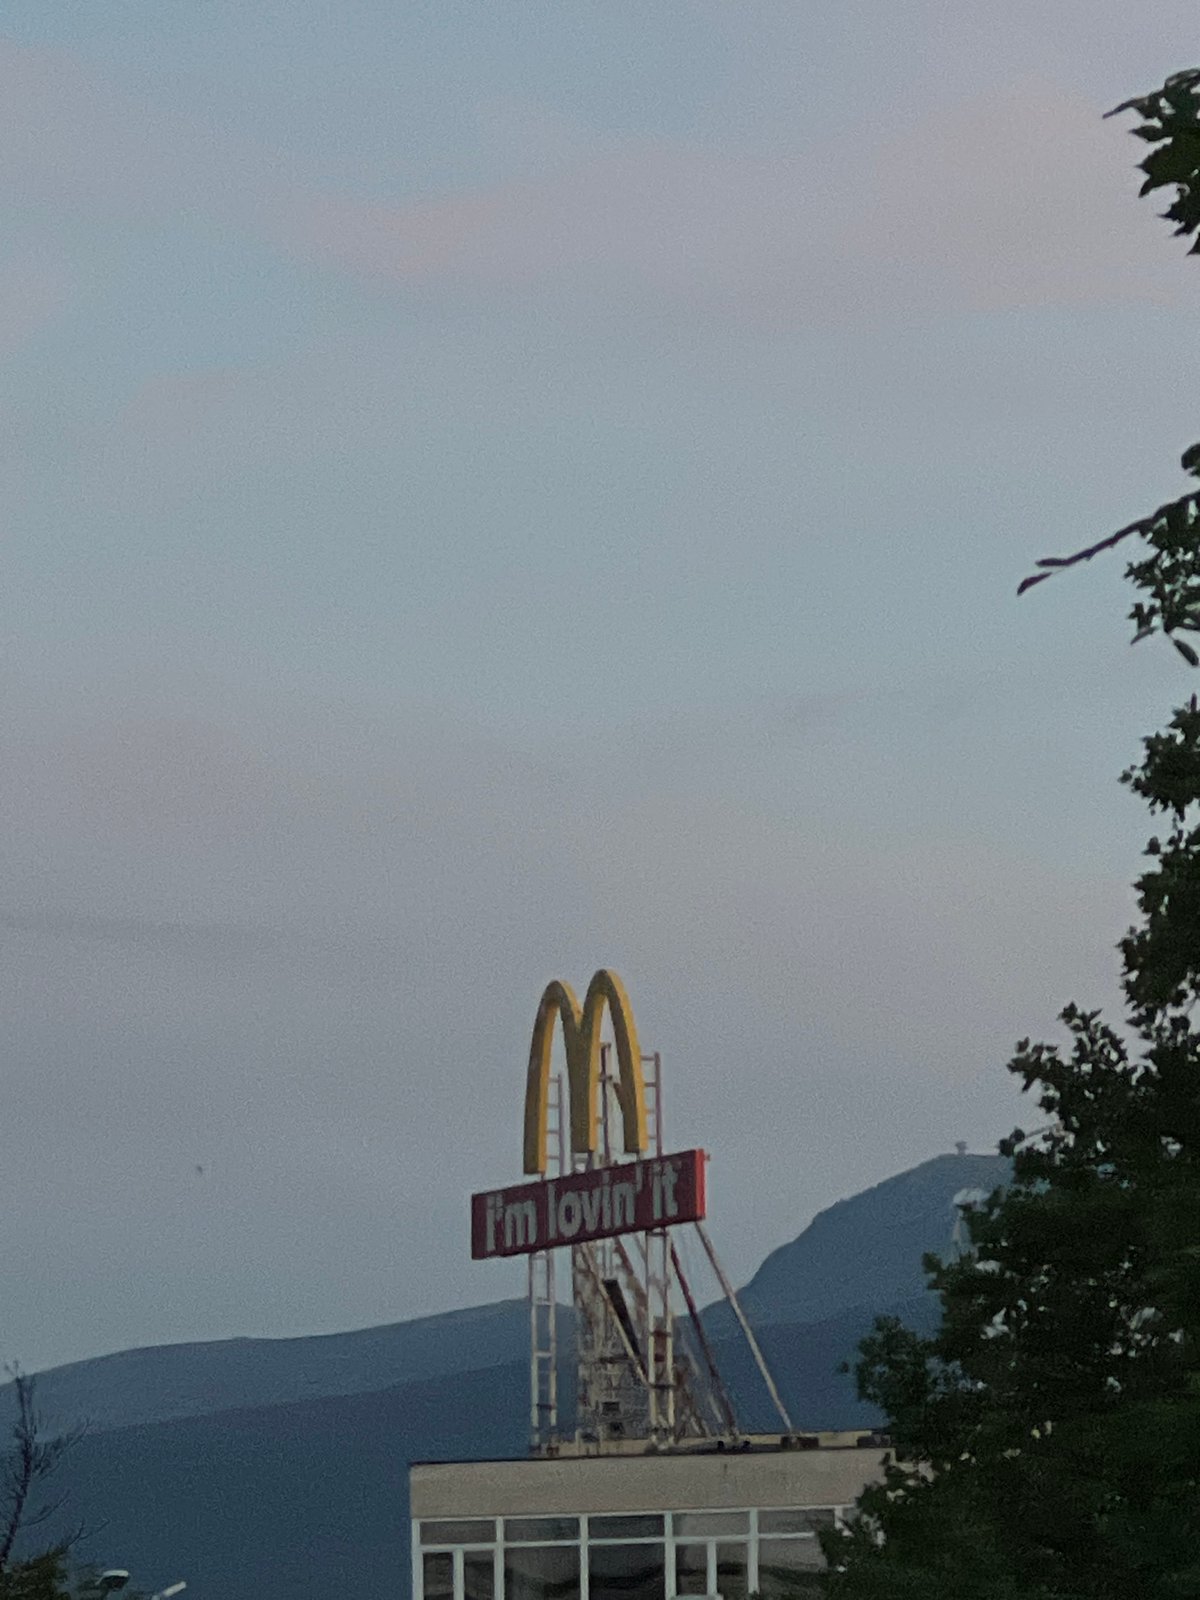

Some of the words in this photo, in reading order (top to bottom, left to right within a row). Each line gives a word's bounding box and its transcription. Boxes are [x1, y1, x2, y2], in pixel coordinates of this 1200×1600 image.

[486, 1194, 538, 1251] i'm
[547, 1163, 643, 1240] lovin'
[652, 1161, 679, 1220] it
